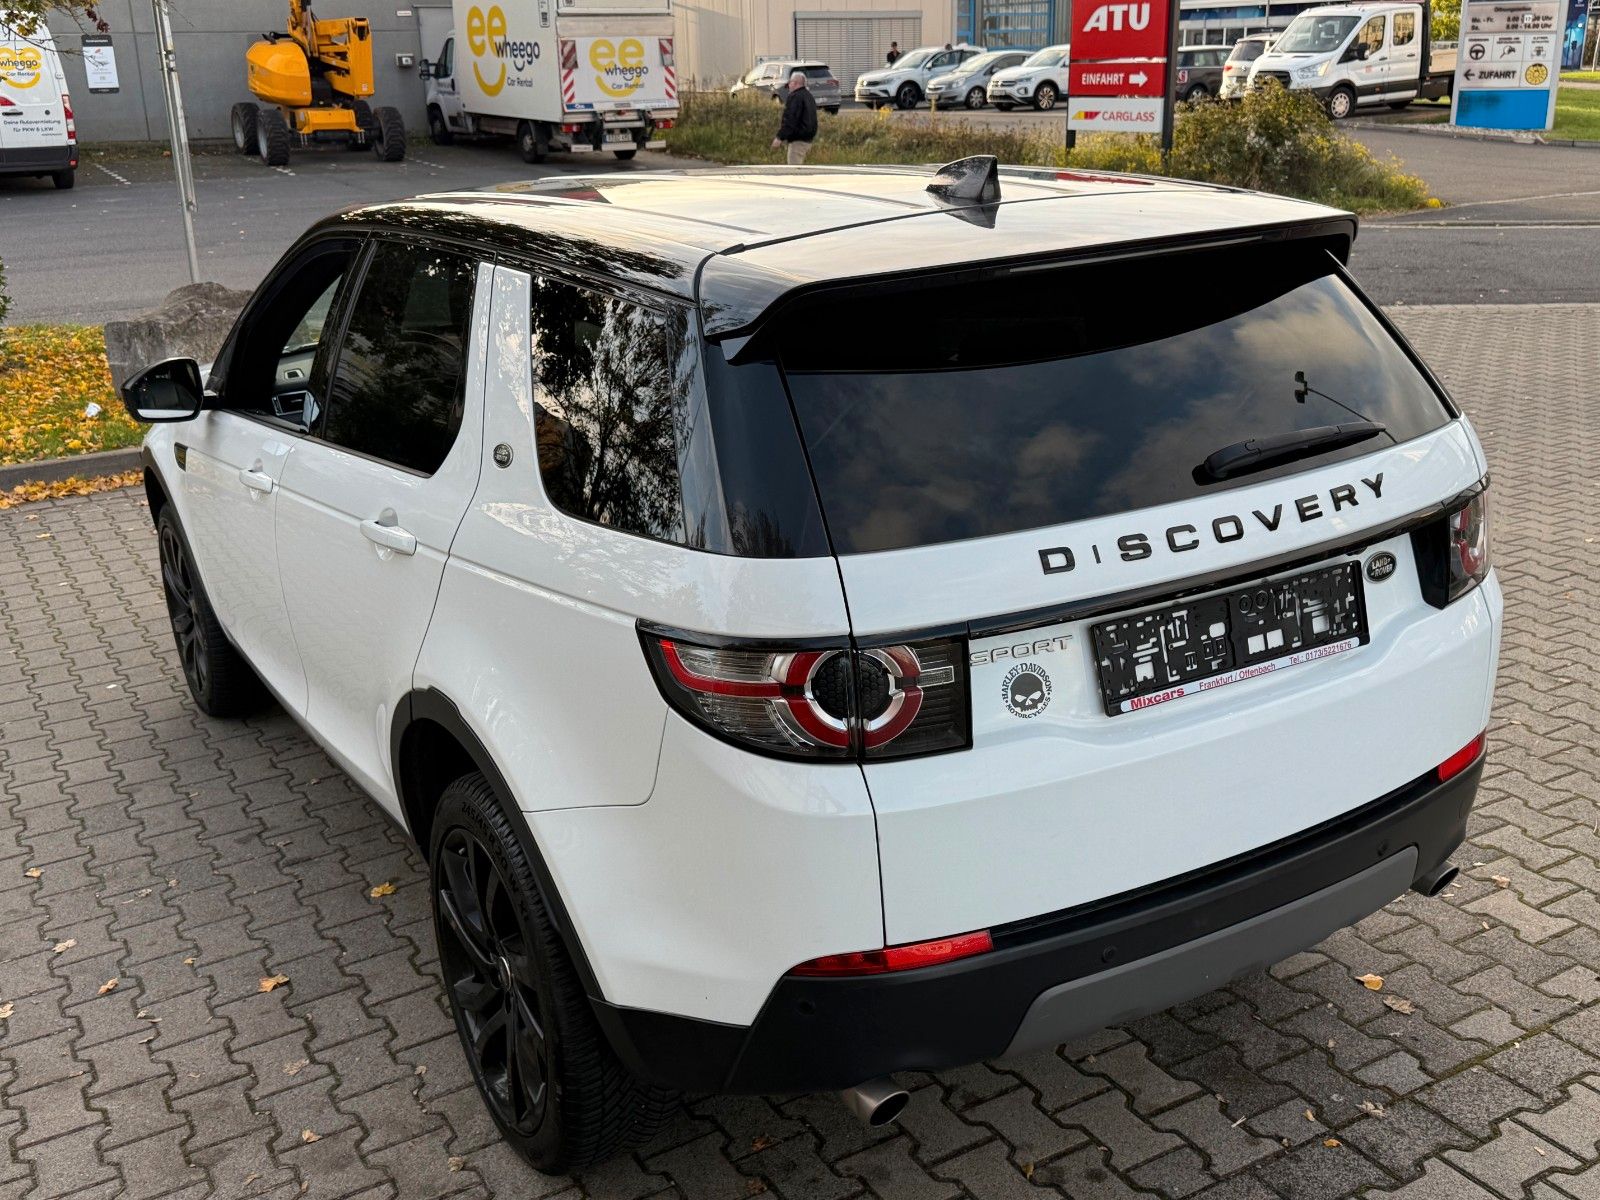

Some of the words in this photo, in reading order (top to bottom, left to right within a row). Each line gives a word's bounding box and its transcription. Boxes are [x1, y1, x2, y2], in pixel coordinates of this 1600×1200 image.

[1082, 3, 1150, 32] ATU
[495, 34, 540, 65] wheego
[507, 77, 516, 86] Car
[517, 77, 533, 87] Rental
[605, 64, 648, 78] wheego
[1081, 72, 1125, 85] EINFAHRT
[1478, 70, 1517, 79] ZUFAHRT
[1102, 111, 1155, 121] CARGLASS
[1038, 472, 1384, 575] DISCOVERY
[970, 635, 1073, 667] SPORT
[1130, 687, 1185, 710] Mixcars
[1199, 674, 1234, 691] Frankfurt
[1238, 662, 1276, 680] Offenbach
[1305, 642, 1352, 660] 0173/5221676
[1006, 696, 1051, 719] MOTORCYCLES
